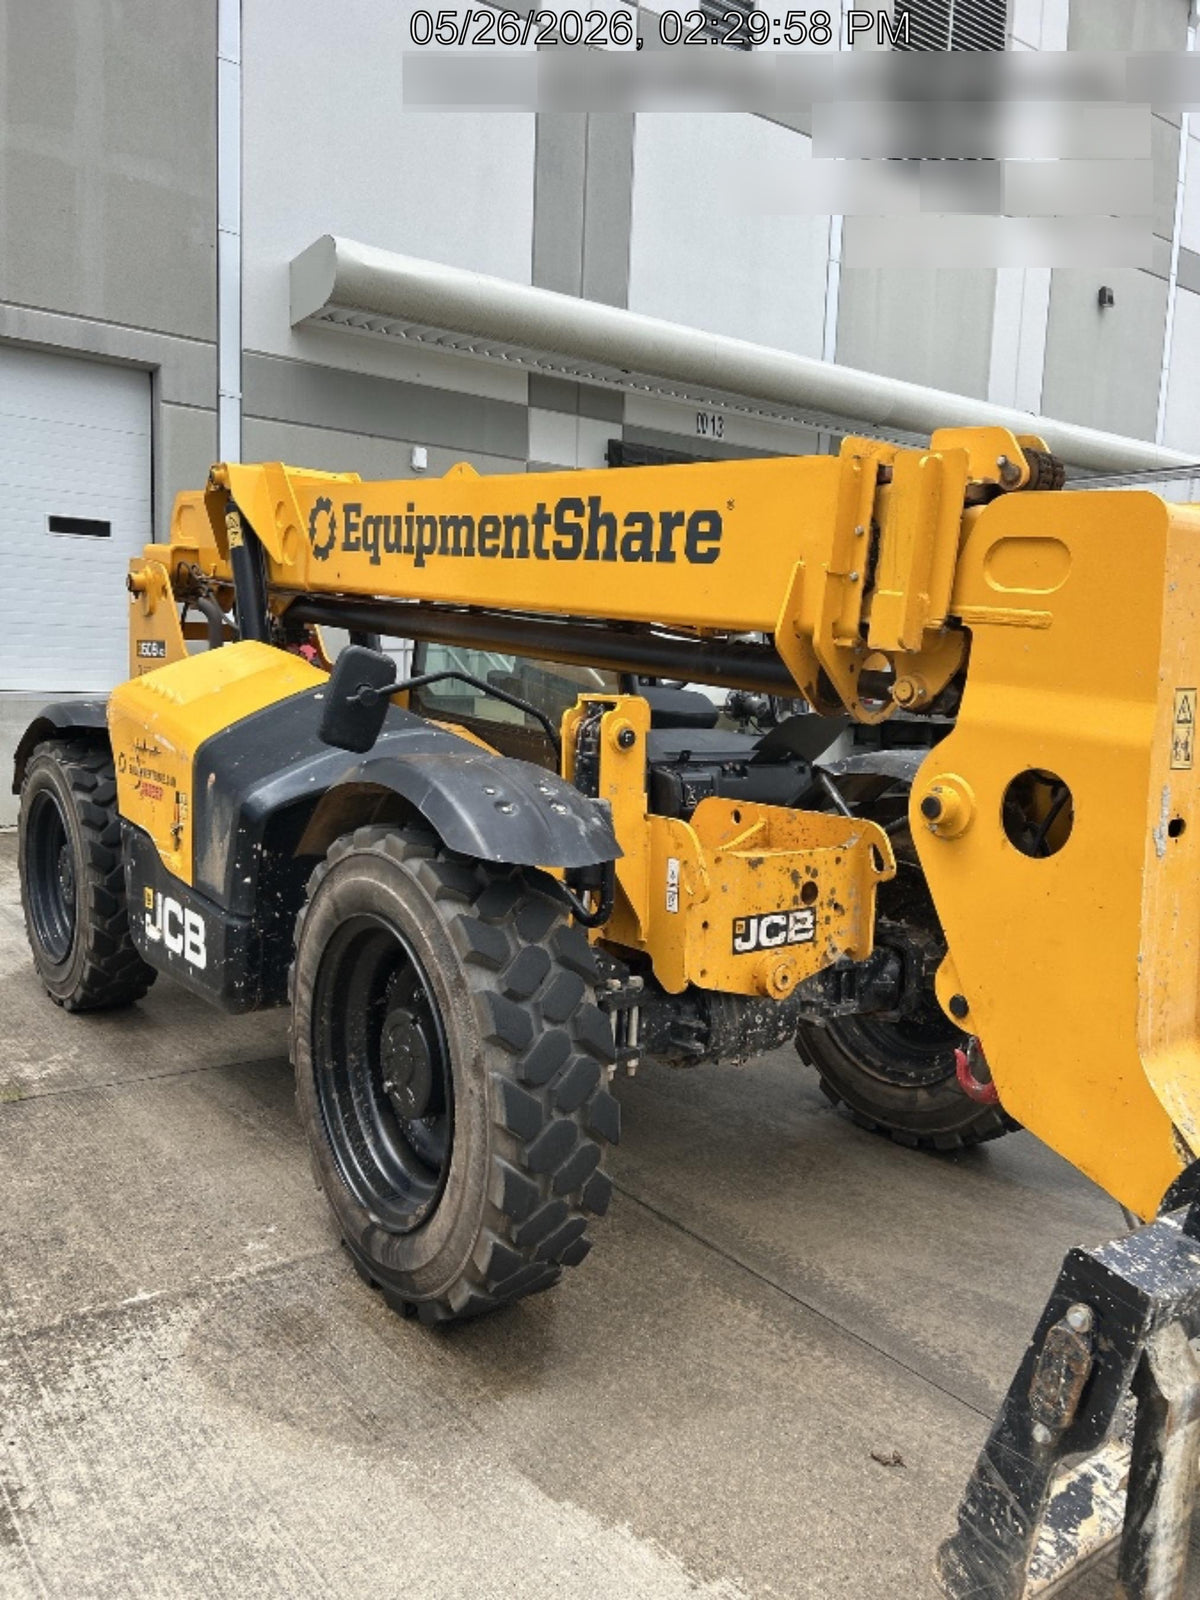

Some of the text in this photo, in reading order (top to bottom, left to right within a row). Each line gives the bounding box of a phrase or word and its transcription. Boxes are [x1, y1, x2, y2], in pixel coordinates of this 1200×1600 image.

[341, 495, 723, 568] EquipmentShare
[145, 891, 207, 970] JCB
[733, 909, 815, 952] JCB
